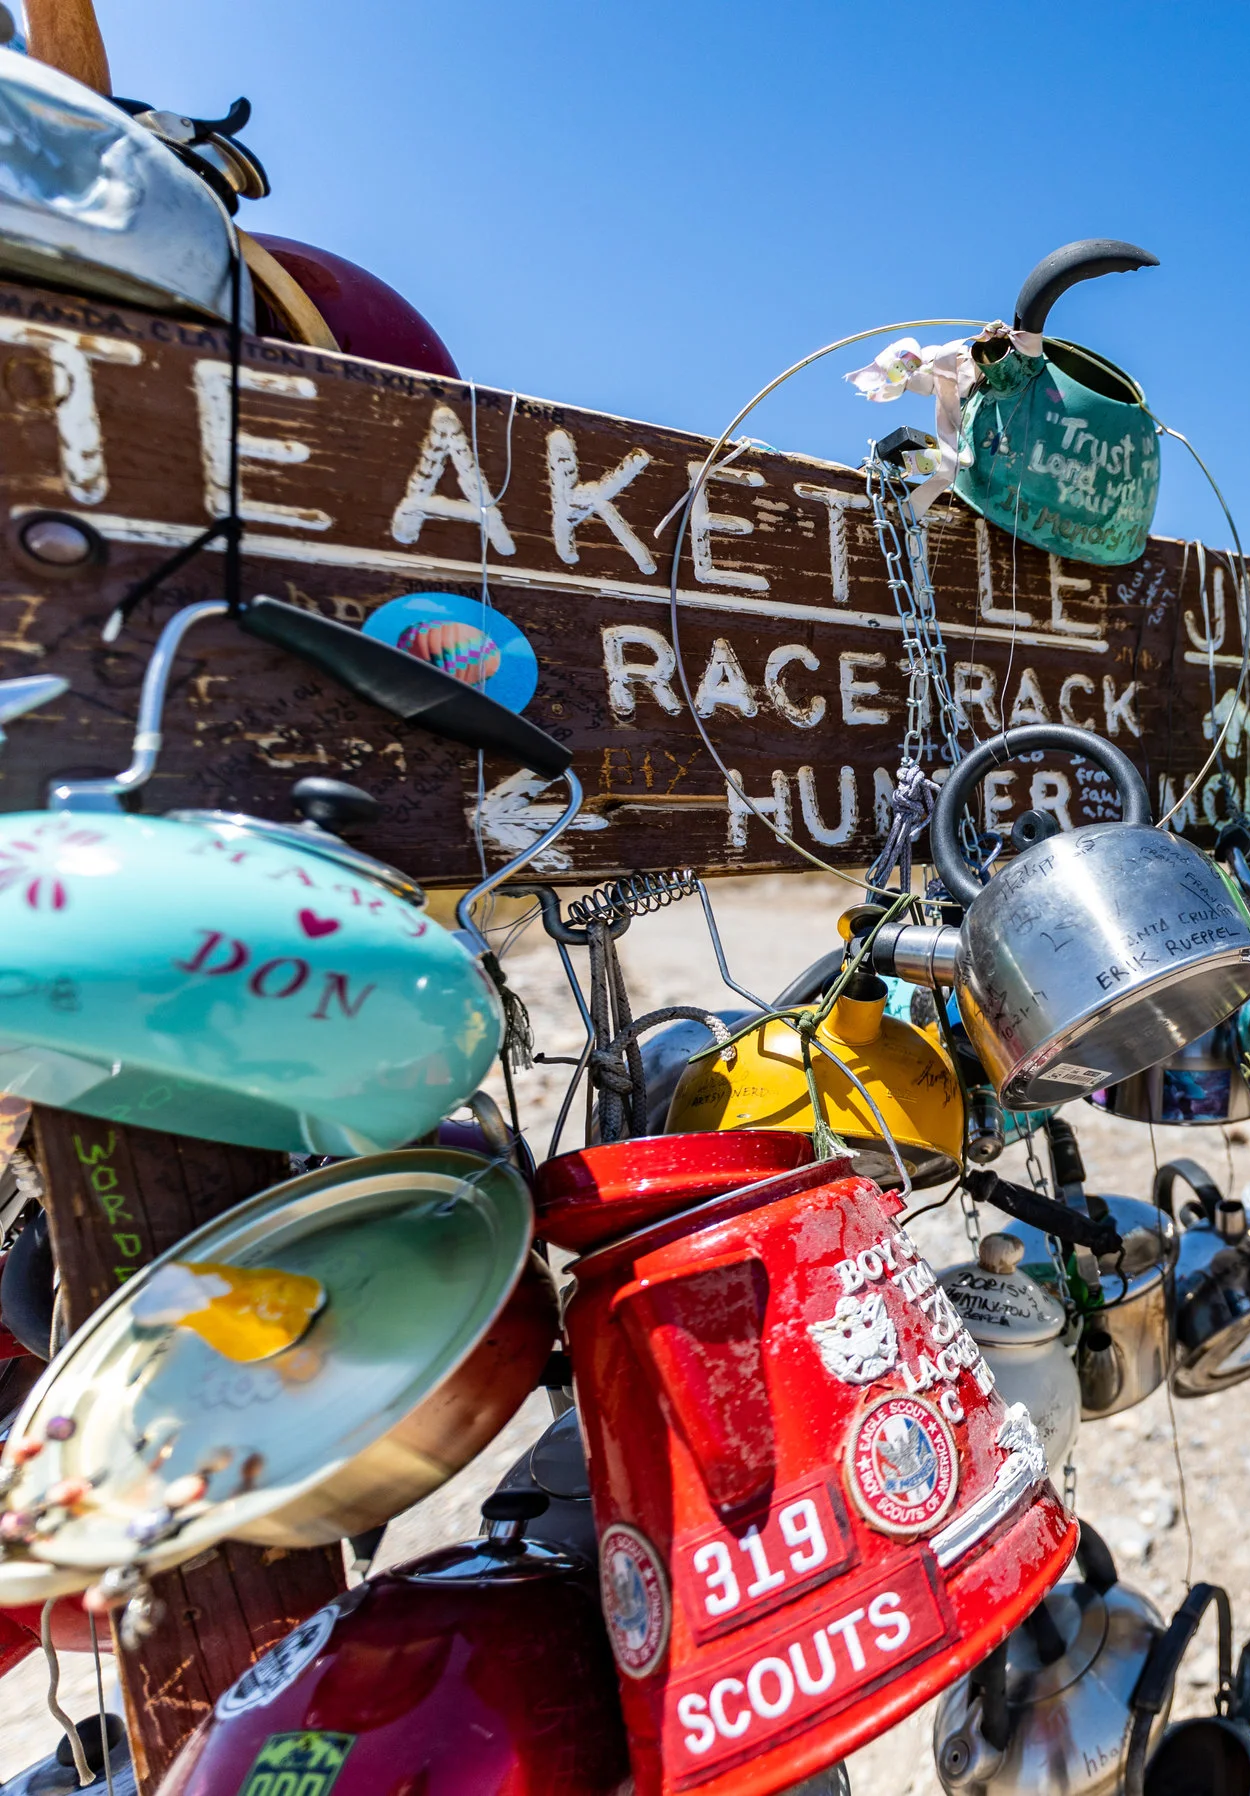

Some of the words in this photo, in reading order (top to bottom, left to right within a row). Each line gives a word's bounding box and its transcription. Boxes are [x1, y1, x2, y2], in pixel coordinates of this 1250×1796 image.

[152, 320, 307, 370] CLATON
[0, 316, 1104, 637] TEAKETTLE
[602, 623, 1144, 738] RACETRACK
[726, 764, 1075, 847] HUNER
[1164, 925, 1241, 957] RUEPPEL
[171, 929, 379, 1021] DON
[833, 1238, 899, 1295] BOY
[858, 1407, 888, 1452] EAGLE
[888, 1401, 929, 1421] SCOUT
[859, 1470, 883, 1499] BOY
[932, 1433, 950, 1496] AMERICA
[875, 1497, 926, 1523] SCOUTS
[925, 1493, 941, 1512] OF
[692, 1497, 829, 1618] 319
[676, 1590, 912, 1756] SCOUTS
